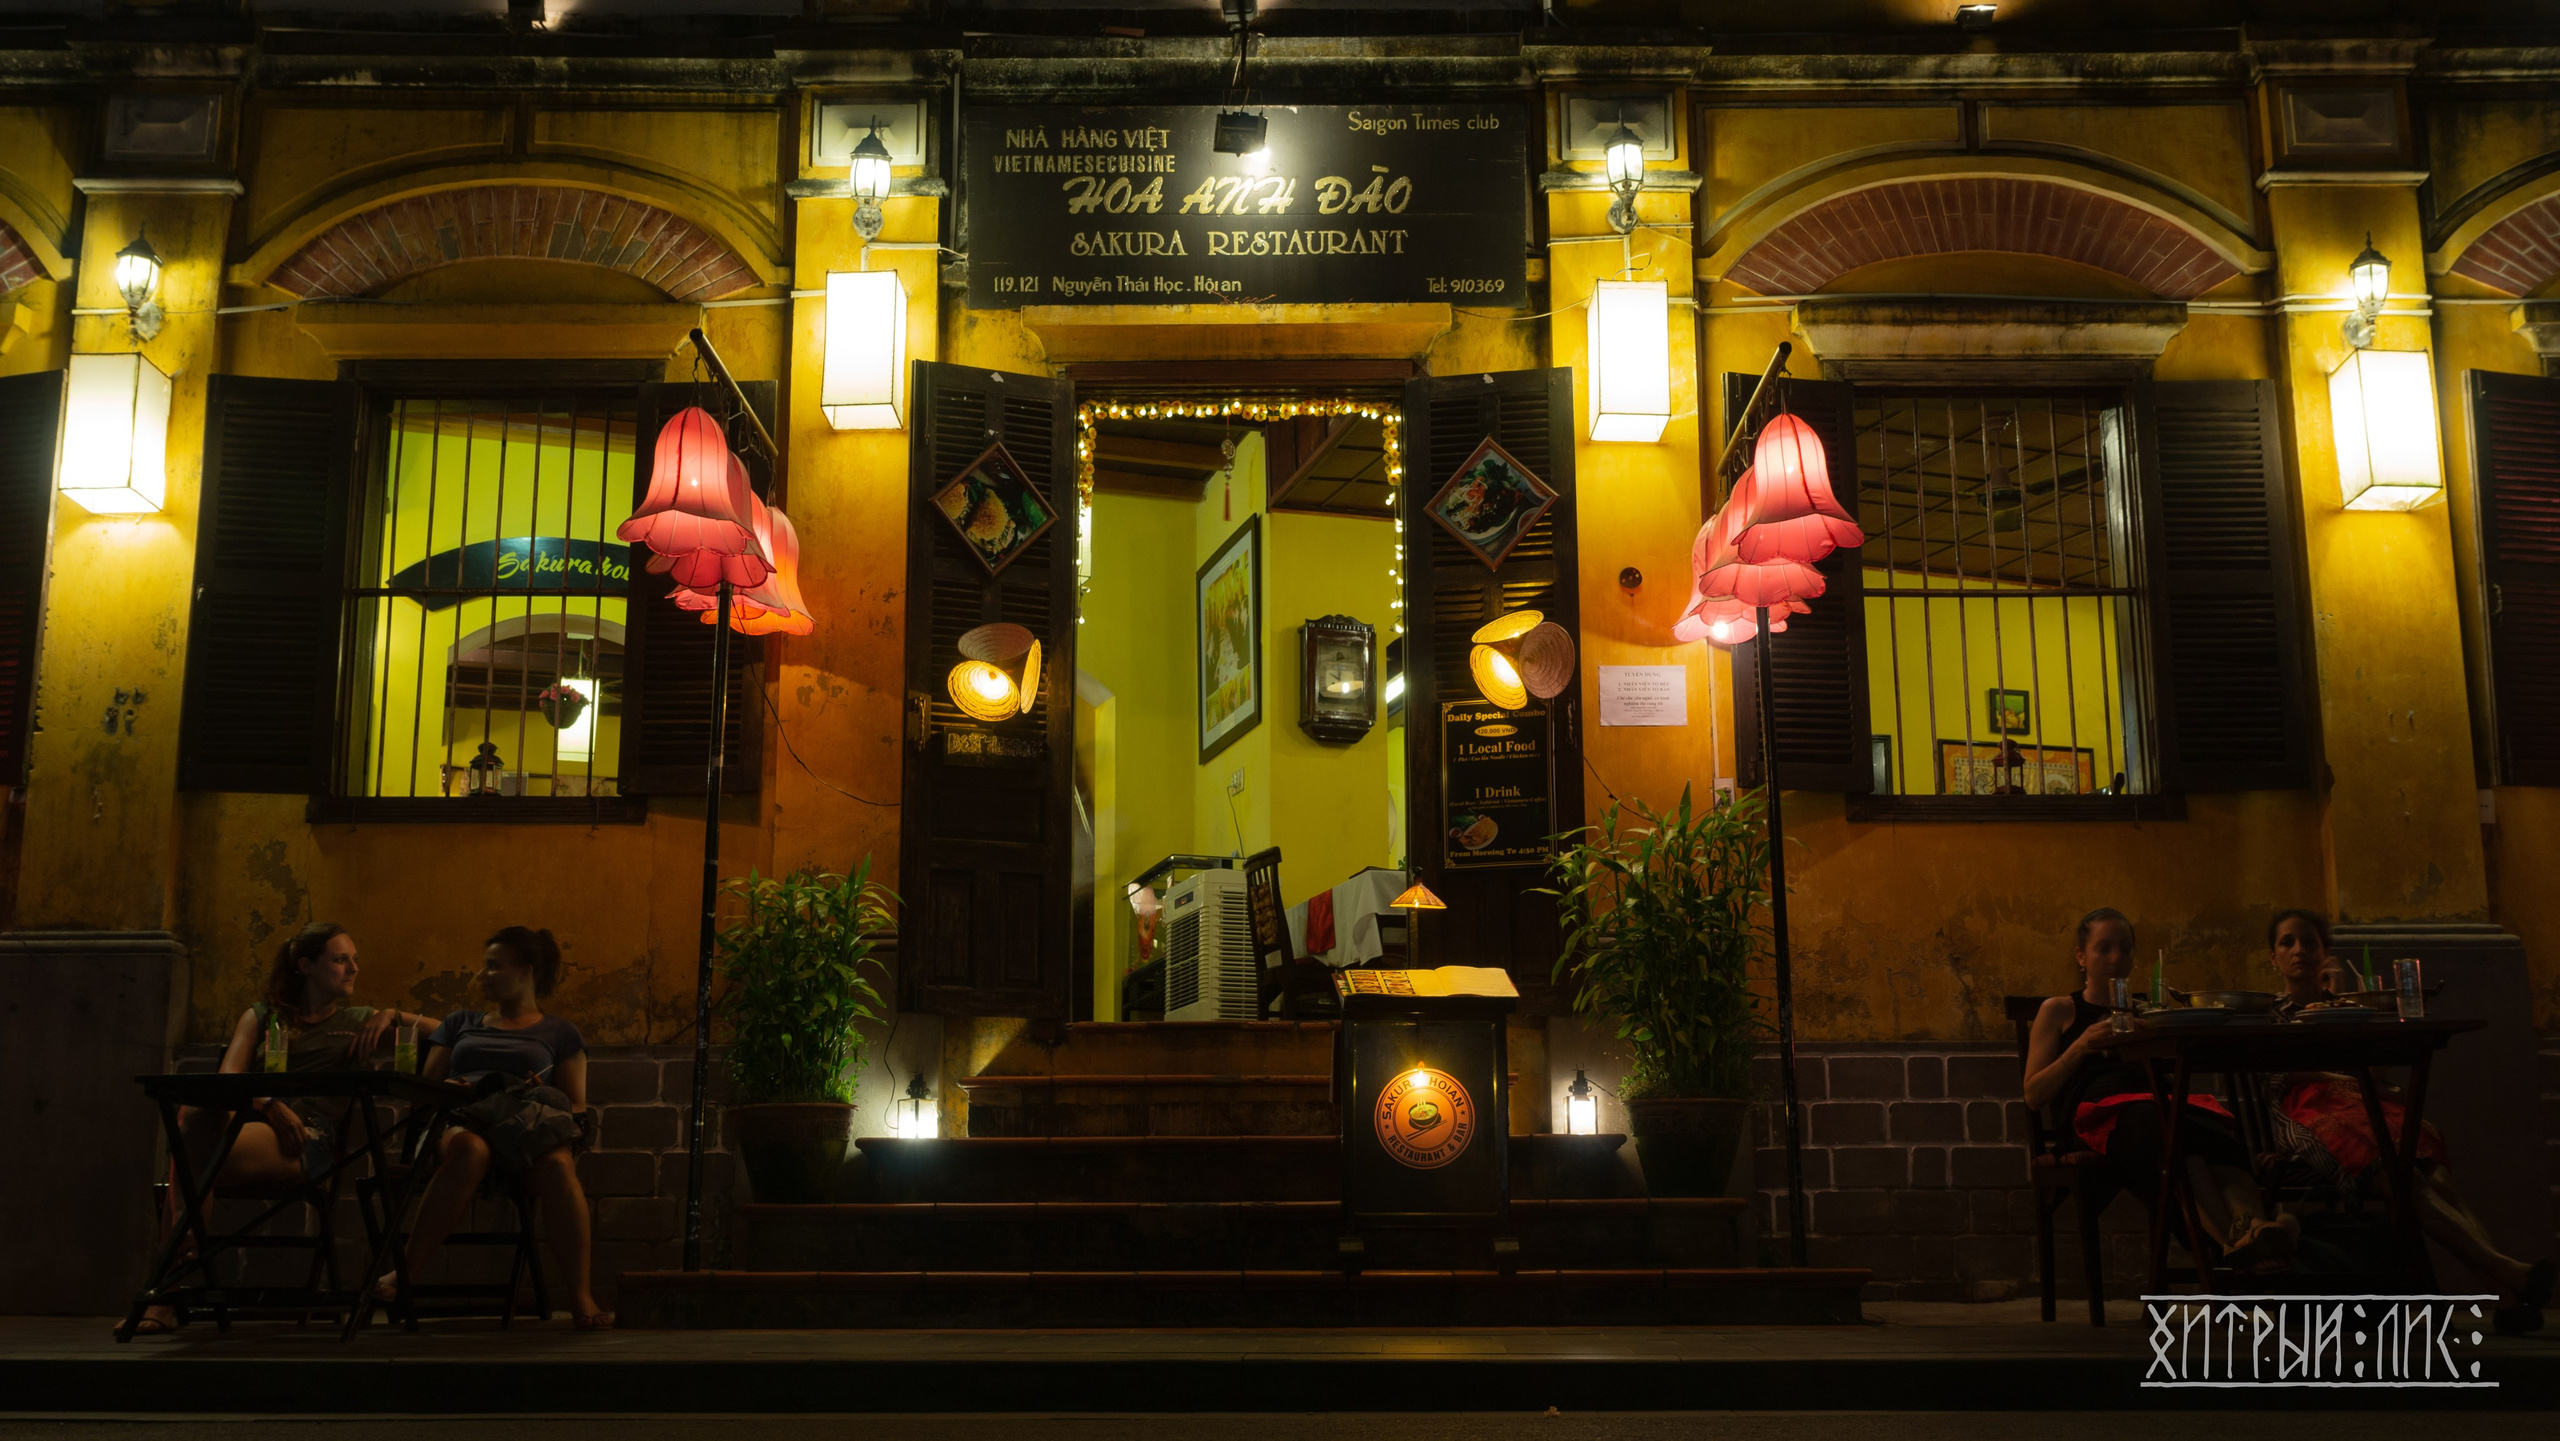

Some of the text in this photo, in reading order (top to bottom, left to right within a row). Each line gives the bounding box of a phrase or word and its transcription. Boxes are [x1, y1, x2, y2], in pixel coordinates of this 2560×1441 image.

[1348, 111, 1500, 136] Saigon Times club
[1006, 124, 1171, 152] NHÀ HÀNG VIỆT
[1063, 165, 1413, 216] HOA ANH ĐÀO
[1070, 229, 1409, 256] SAKURA RESTAURANT
[1053, 276, 1112, 297] Nguyễn
[1115, 275, 1149, 292] Thái
[1426, 277, 1505, 293] Tel: 910369
[498, 551, 592, 579] Sakura
[1447, 709, 1546, 722] Daily Special Combo
[1459, 740, 1536, 755] 1 Local Food
[1475, 785, 1521, 799] 1 Drink
[1472, 848, 1505, 857] Morning
[1382, 1076, 1465, 1120] SAKUR HOIAN
[1388, 1122, 1468, 1162] RESTAURANT & BAR
